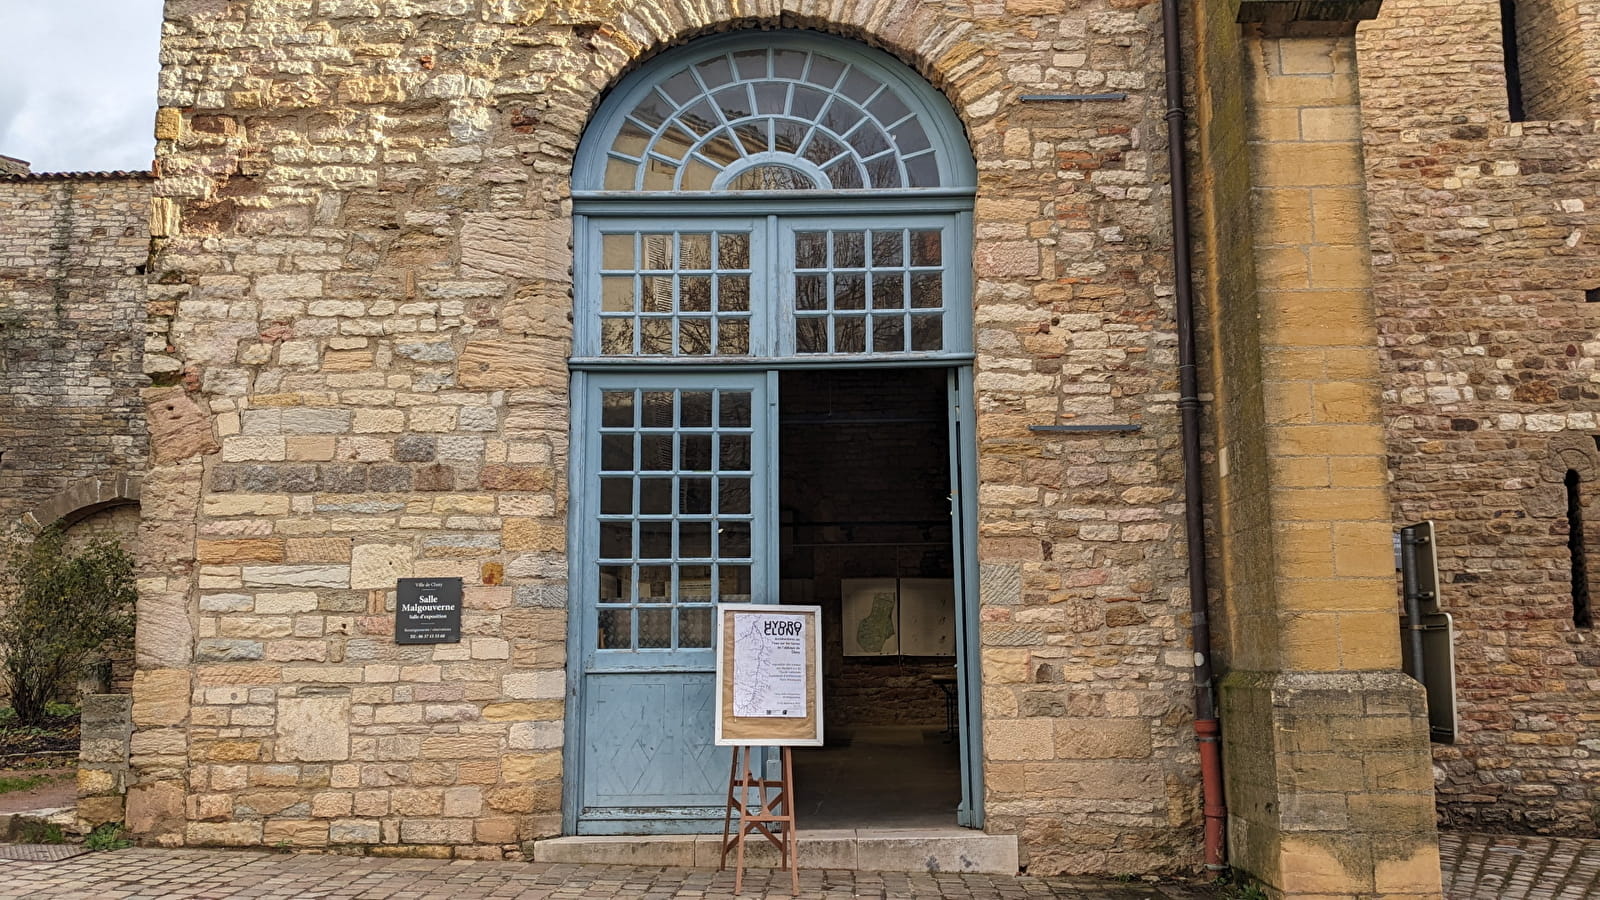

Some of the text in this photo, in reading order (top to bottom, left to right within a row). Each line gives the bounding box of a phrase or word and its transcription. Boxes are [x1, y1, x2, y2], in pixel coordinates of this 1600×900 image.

[419, 595, 438, 603] Salle
[402, 604, 455, 613] Malgouverne
[764, 620, 802, 629] HYDRO
[764, 628, 802, 636] CLUNY
